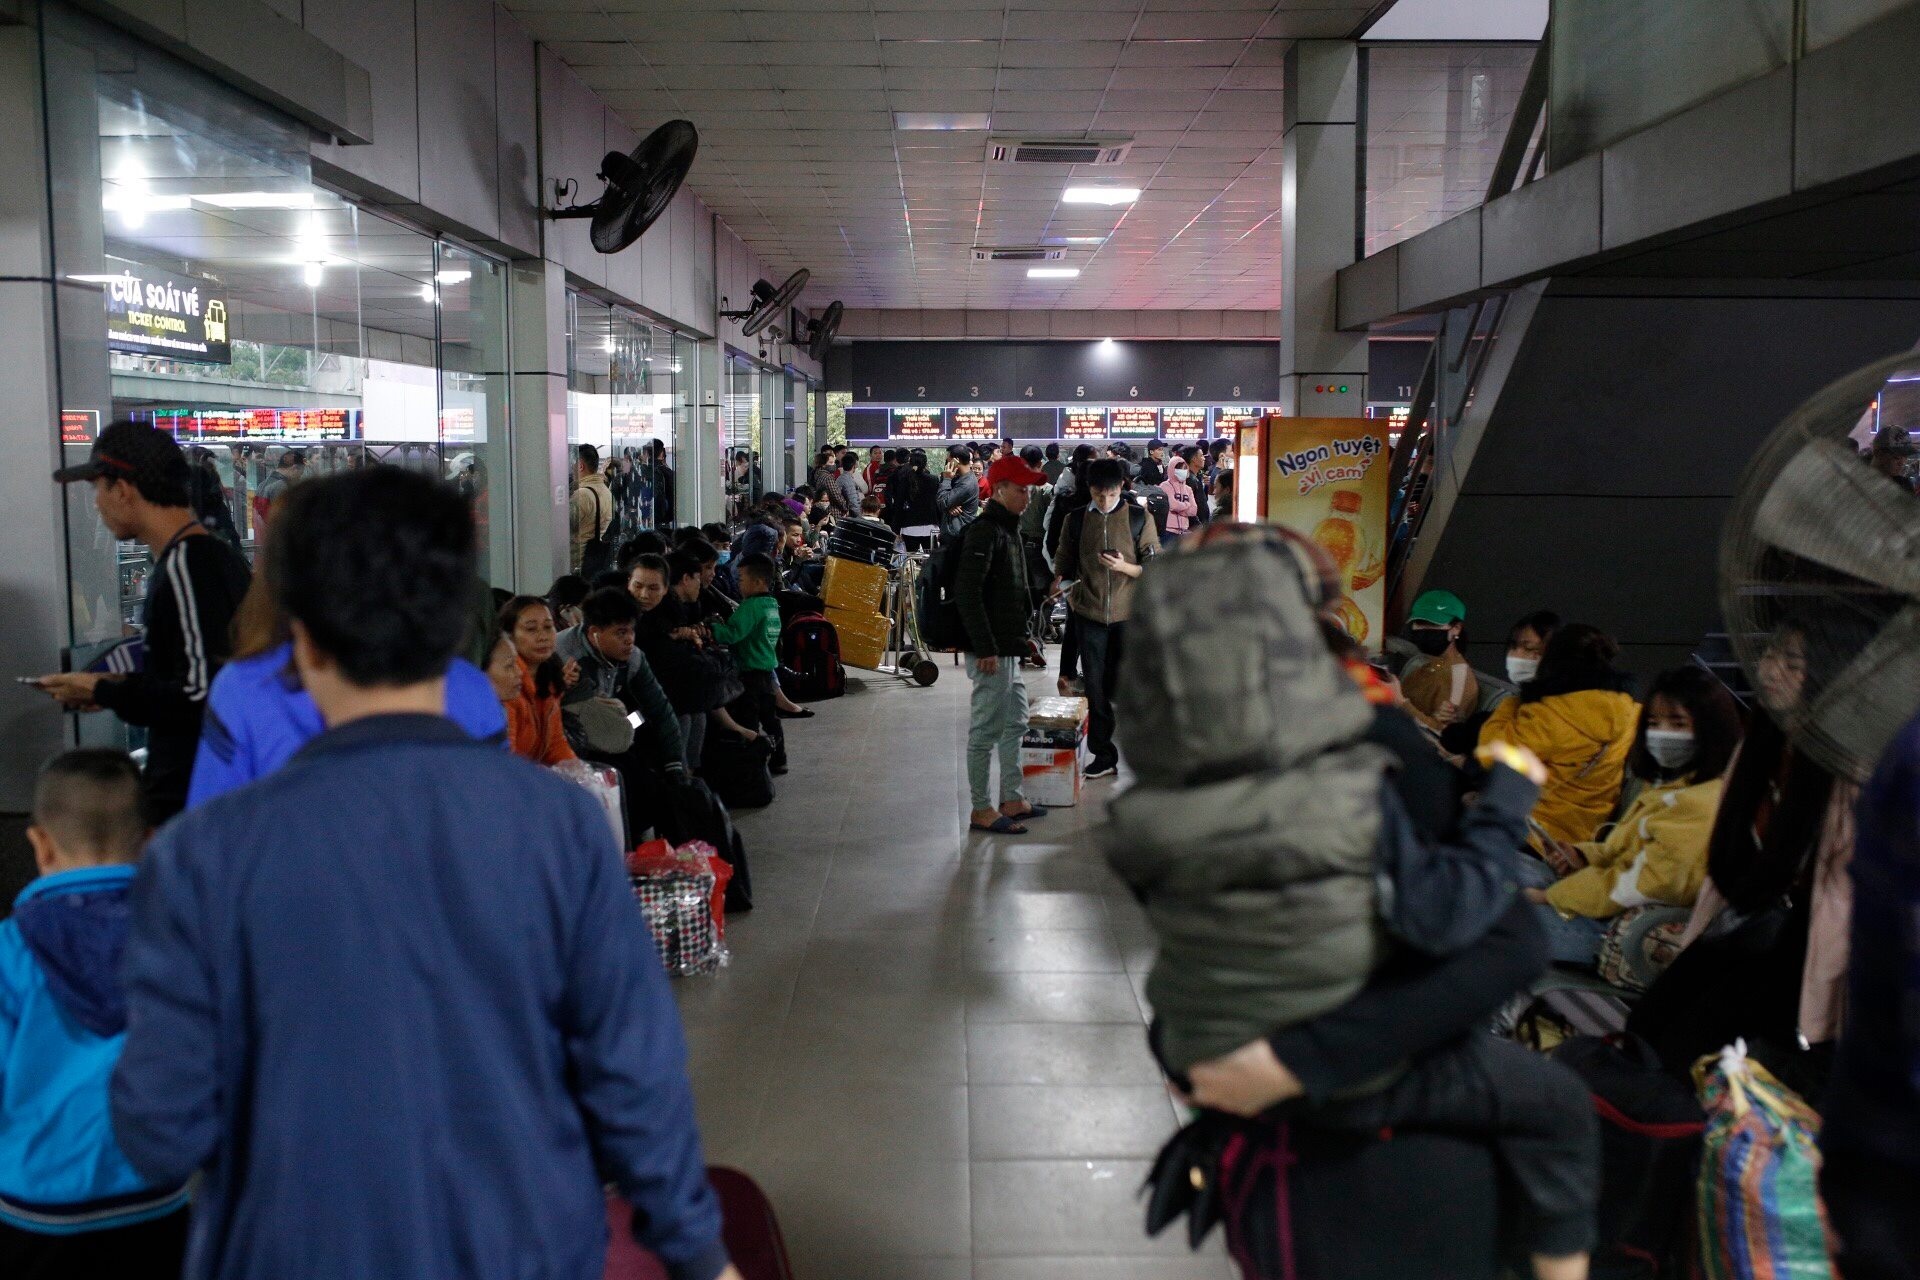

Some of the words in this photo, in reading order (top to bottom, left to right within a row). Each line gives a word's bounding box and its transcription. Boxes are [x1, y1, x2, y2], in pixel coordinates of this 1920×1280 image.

[146, 281, 180, 312] SOÁT
[182, 287, 200, 317] VÉ
[128, 310, 153, 328] TICKET
[154, 315, 187, 333] CONTROL
[865, 386, 871, 397] 1
[917, 386, 926, 397] 2
[970, 386, 979, 397] 3
[1024, 386, 1034, 397] 4
[1076, 386, 1085, 397] 5
[1129, 386, 1138, 397] 6
[1187, 386, 1195, 397] 7
[1232, 386, 1241, 397] 8
[1398, 386, 1411, 397] 11
[1277, 446, 1329, 476] Ngon
[1333, 436, 1381, 456] tuyệt
[1305, 467, 1324, 484] vị
[1326, 468, 1361, 480] cam
